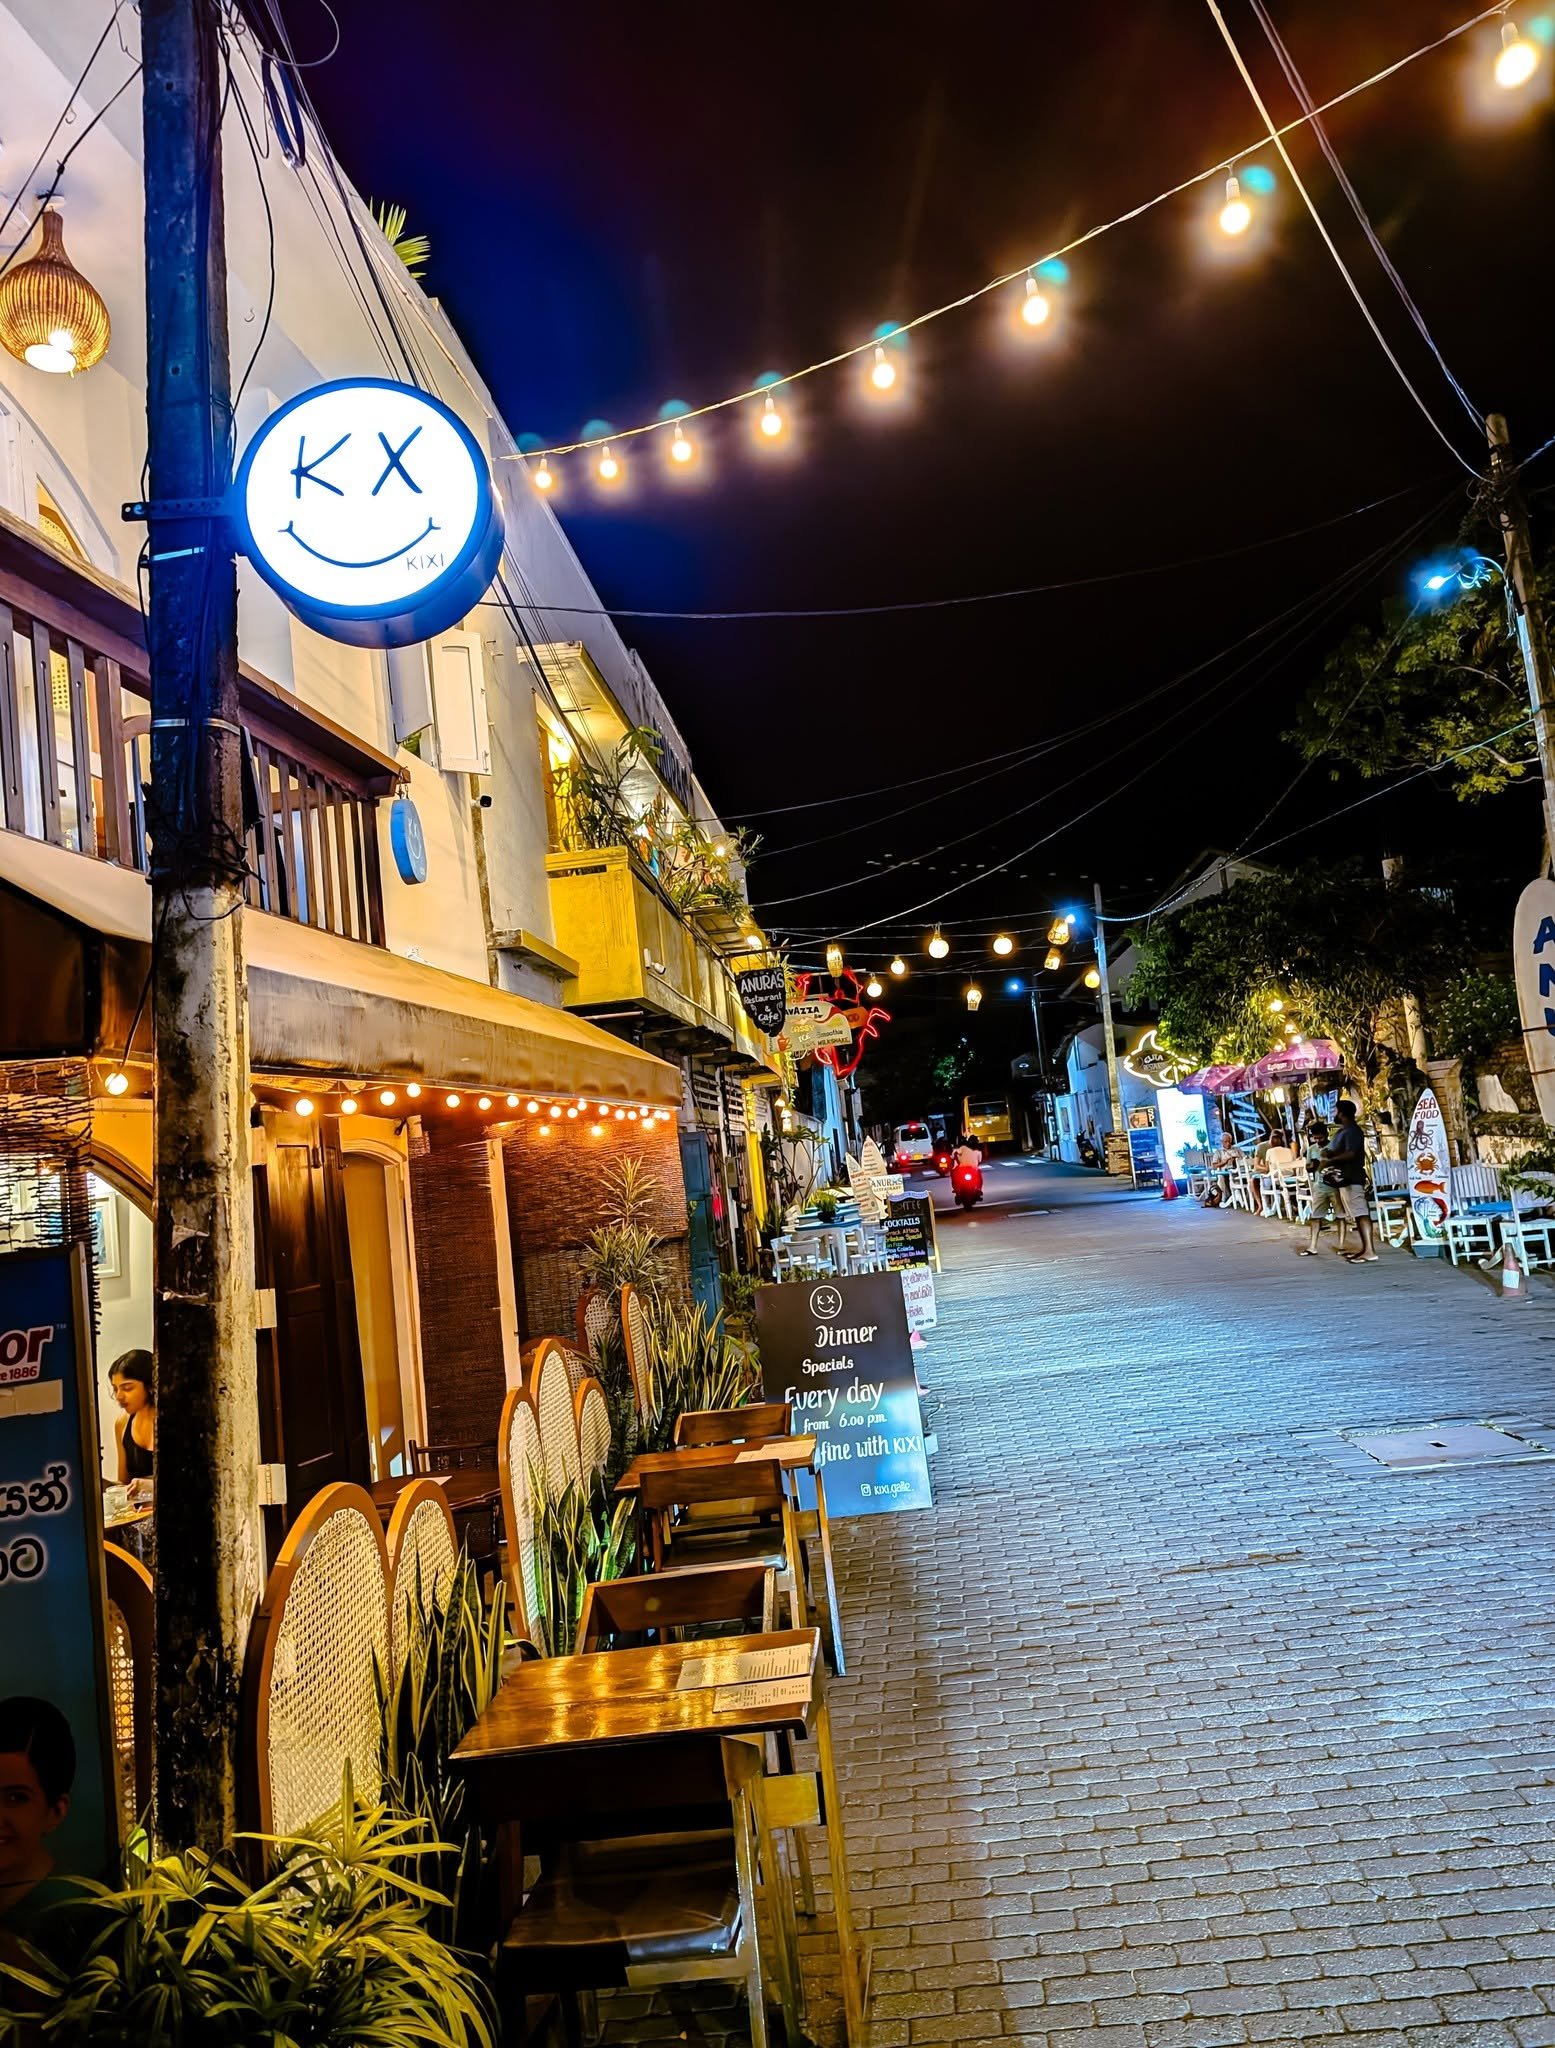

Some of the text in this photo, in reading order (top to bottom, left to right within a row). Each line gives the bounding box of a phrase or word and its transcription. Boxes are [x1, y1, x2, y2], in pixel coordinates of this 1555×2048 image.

[406, 552, 445, 571] KIXI
[743, 991, 782, 1005] Restaurant
[1417, 1097, 1437, 1111] SEA
[1414, 1110, 1440, 1120] FOOD
[884, 1217, 921, 1228] COCKTAILS
[814, 1324, 878, 1348] Dinner
[8, 1365, 38, 1380] 1886
[802, 1356, 854, 1377] Specials
[784, 1376, 884, 1417] Every day
[803, 1418, 830, 1435] from
[839, 1413, 864, 1428] 6.00
[855, 1434, 891, 1458] with
